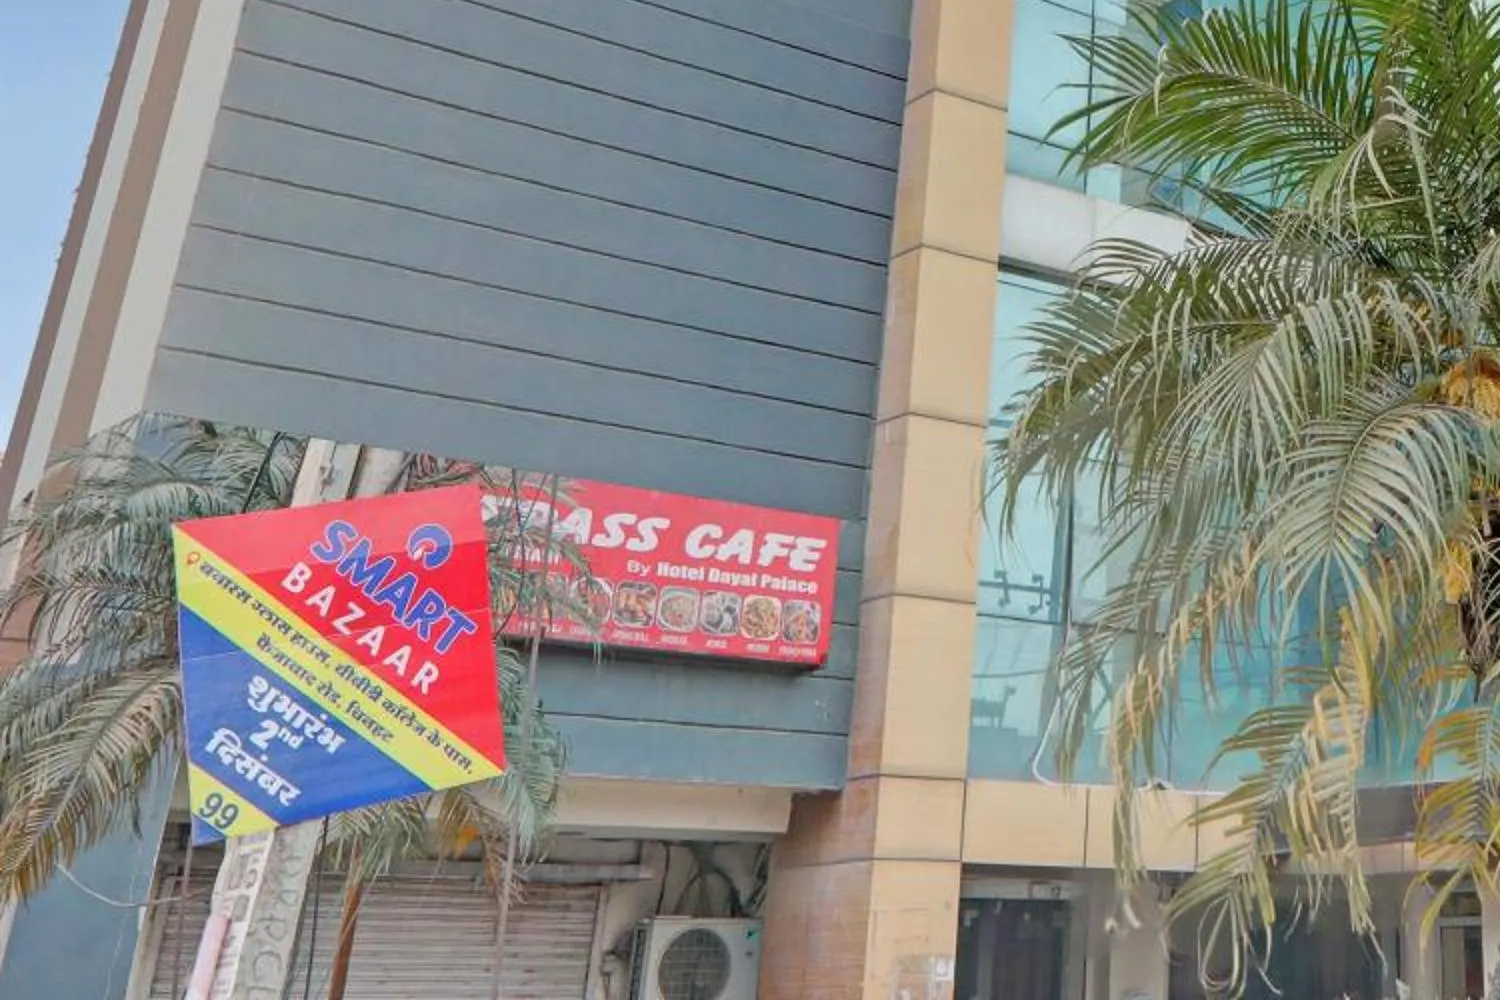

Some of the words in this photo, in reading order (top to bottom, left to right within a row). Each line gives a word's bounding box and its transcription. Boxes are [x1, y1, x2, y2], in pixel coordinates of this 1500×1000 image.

[627, 560, 651, 576] By
[657, 562, 704, 580] Hotel
[708, 568, 756, 587] Dayal
[684, 524, 826, 573] CAFE
[310, 519, 478, 655] SMART
[281, 561, 440, 695] BAZAAR
[248, 675, 346, 753] शुभारंभ
[250, 720, 304, 749] 2nd
[205, 728, 301, 806] दिसंबर
[200, 792, 239, 829] 99
